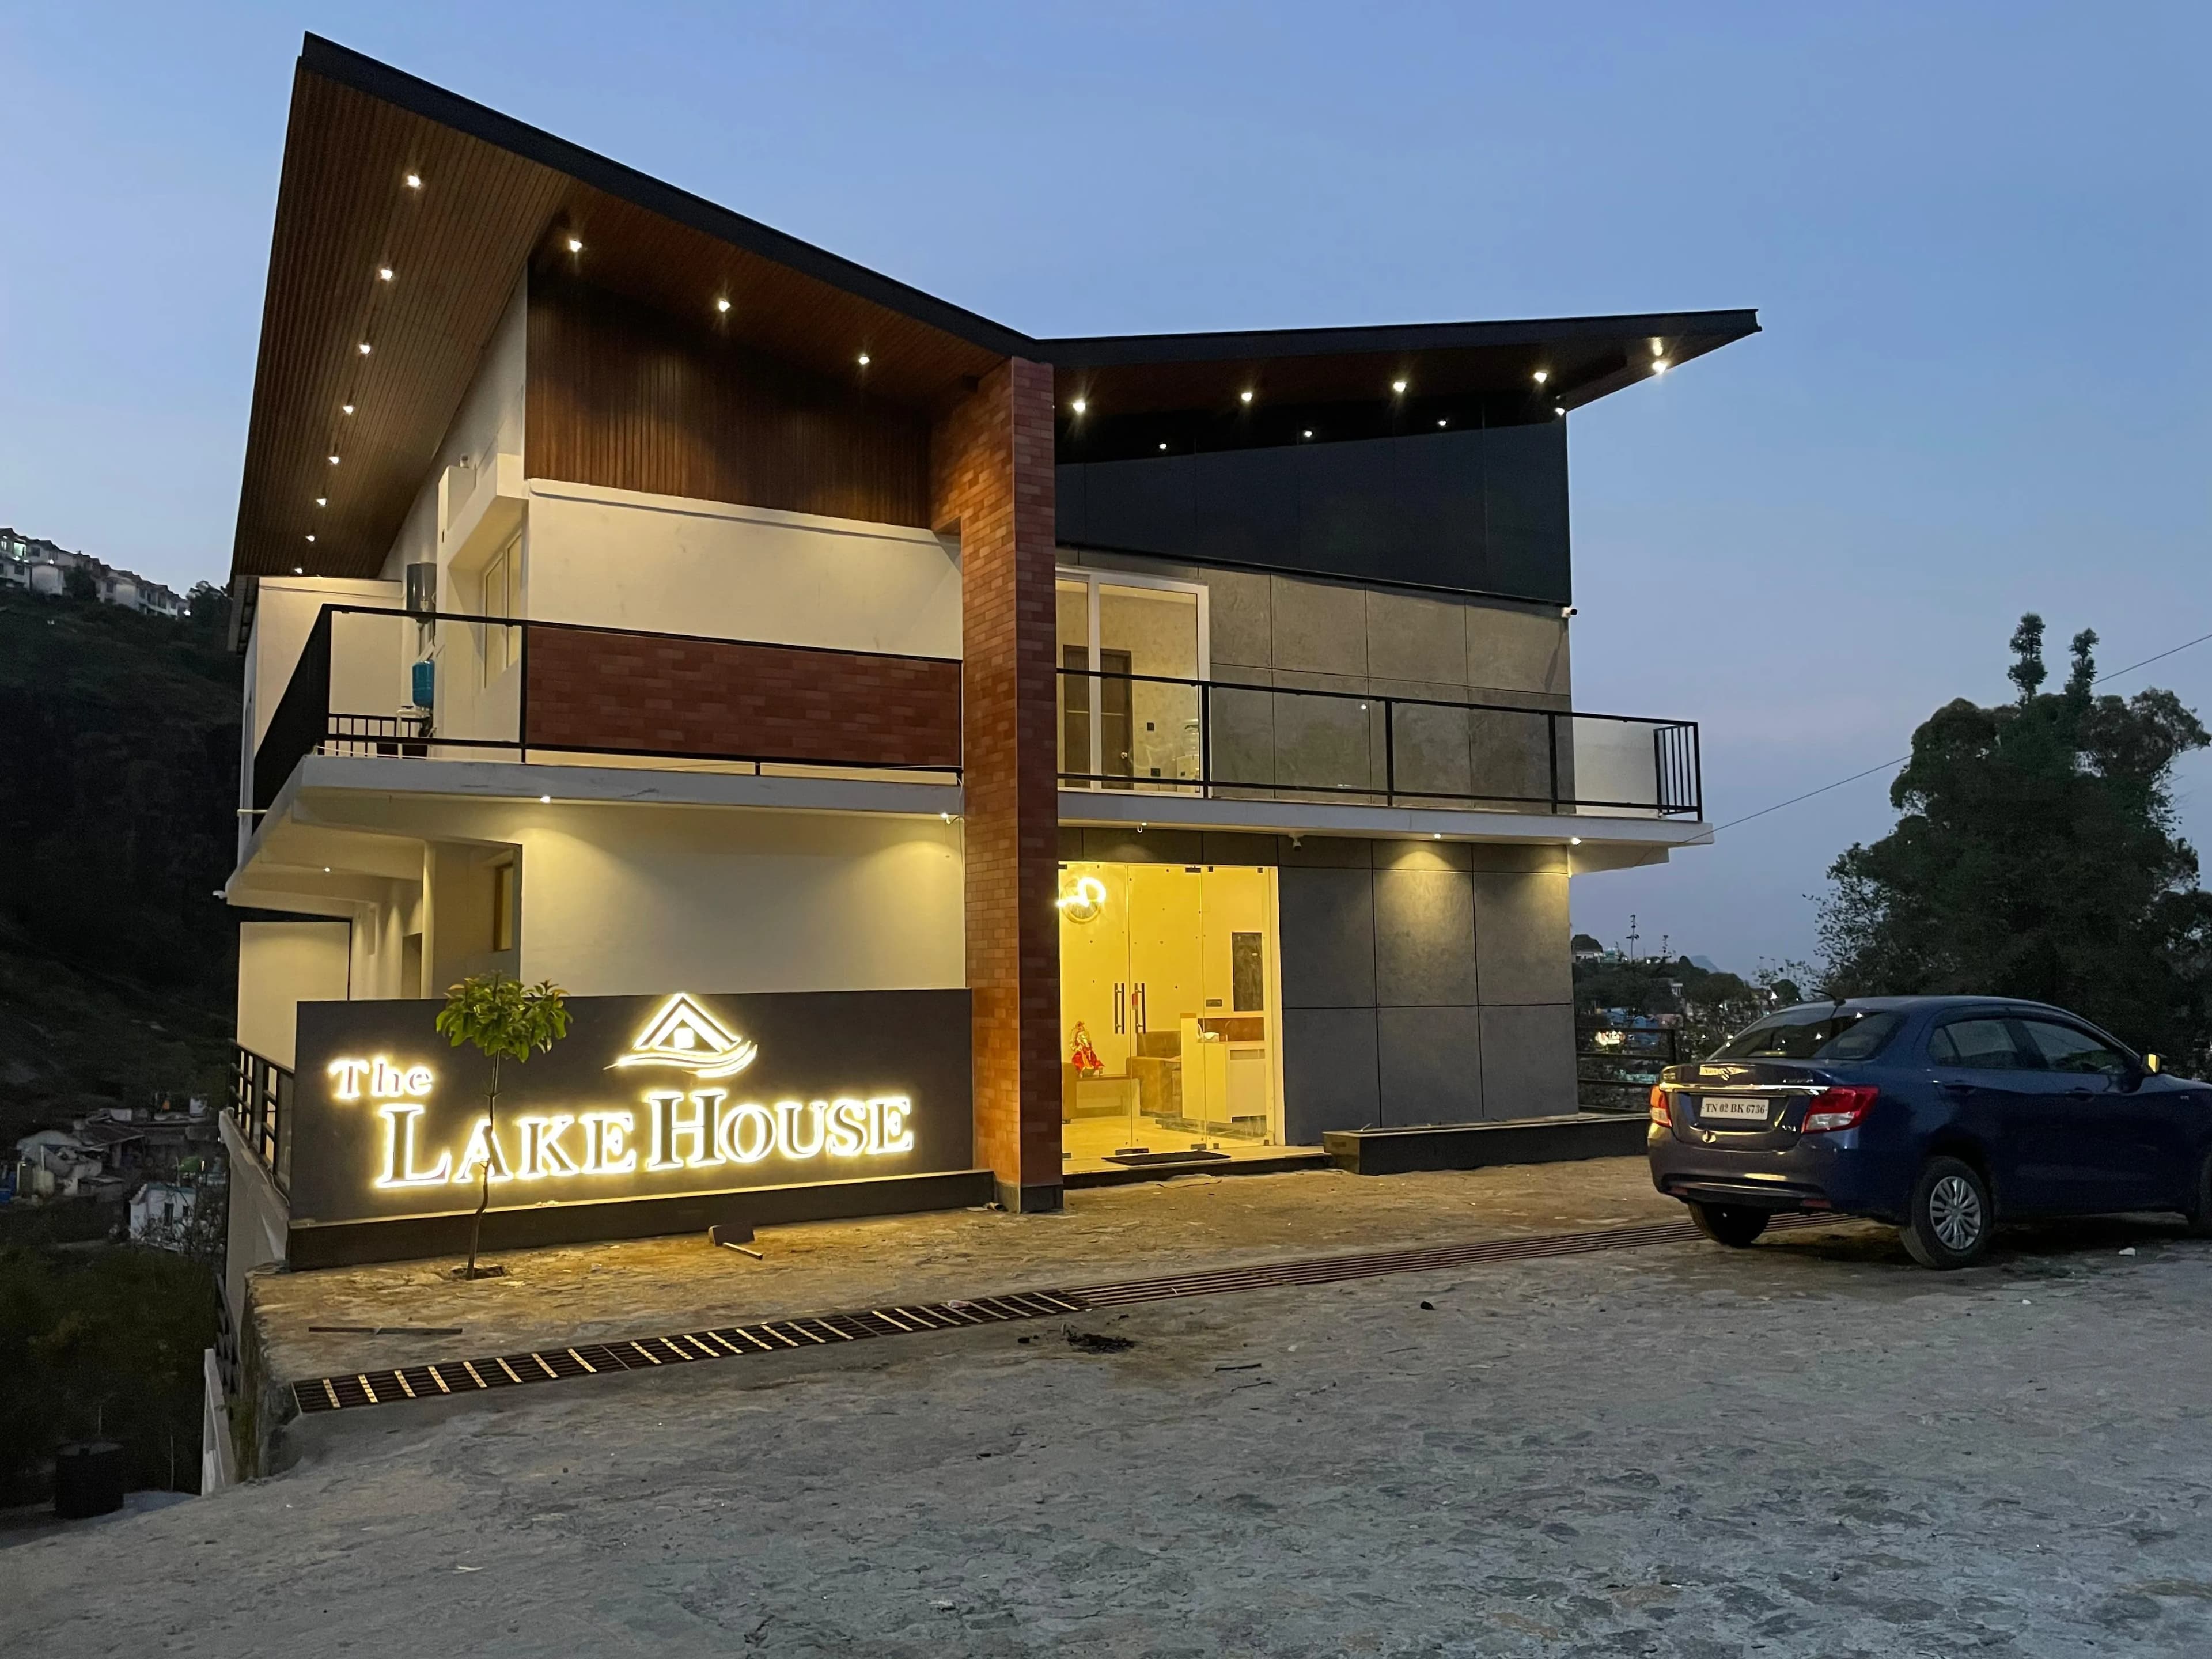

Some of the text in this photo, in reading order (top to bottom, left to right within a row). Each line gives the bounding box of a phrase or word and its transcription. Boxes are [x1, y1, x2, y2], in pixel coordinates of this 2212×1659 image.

[327, 1056, 433, 1100] The
[1706, 1103, 1765, 1115] TN 02 BK 6736
[375, 1087, 915, 1188] LAKE HOUSE
